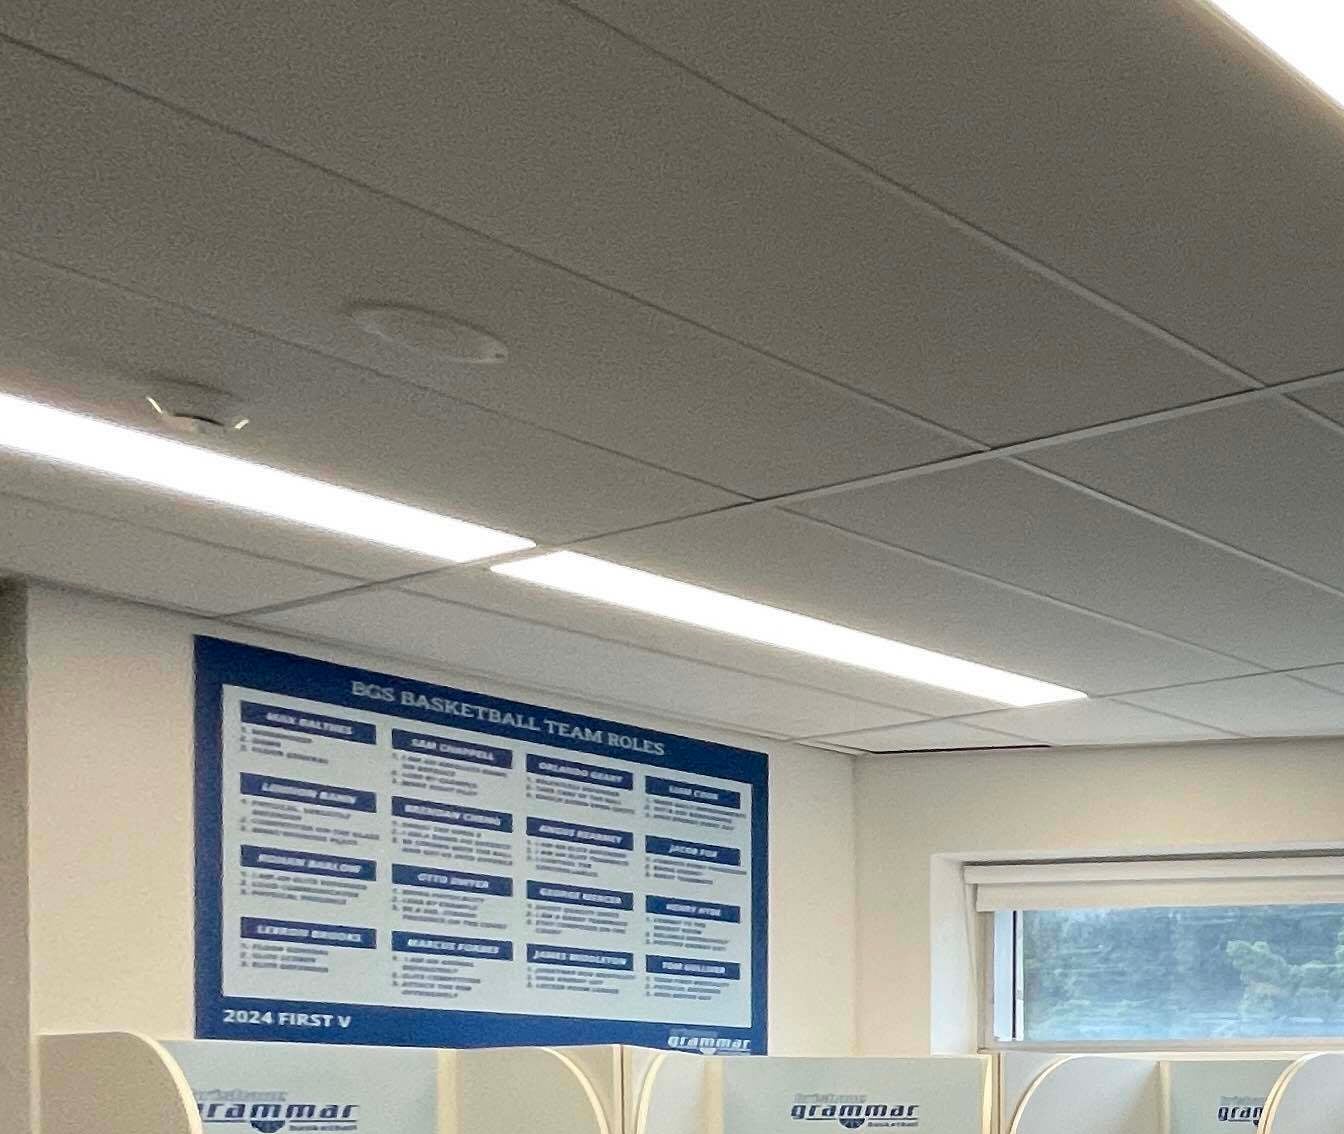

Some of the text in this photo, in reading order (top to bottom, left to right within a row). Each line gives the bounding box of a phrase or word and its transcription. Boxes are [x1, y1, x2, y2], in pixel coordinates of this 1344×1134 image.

[352, 681, 665, 756] BGS BASKETBALL TEAM ROLES
[223, 1009, 351, 1028] 2024 FIRST V
[667, 1036, 751, 1050] grammar
[791, 1104, 919, 1120] grammar
[1218, 1107, 1263, 1121] gra
